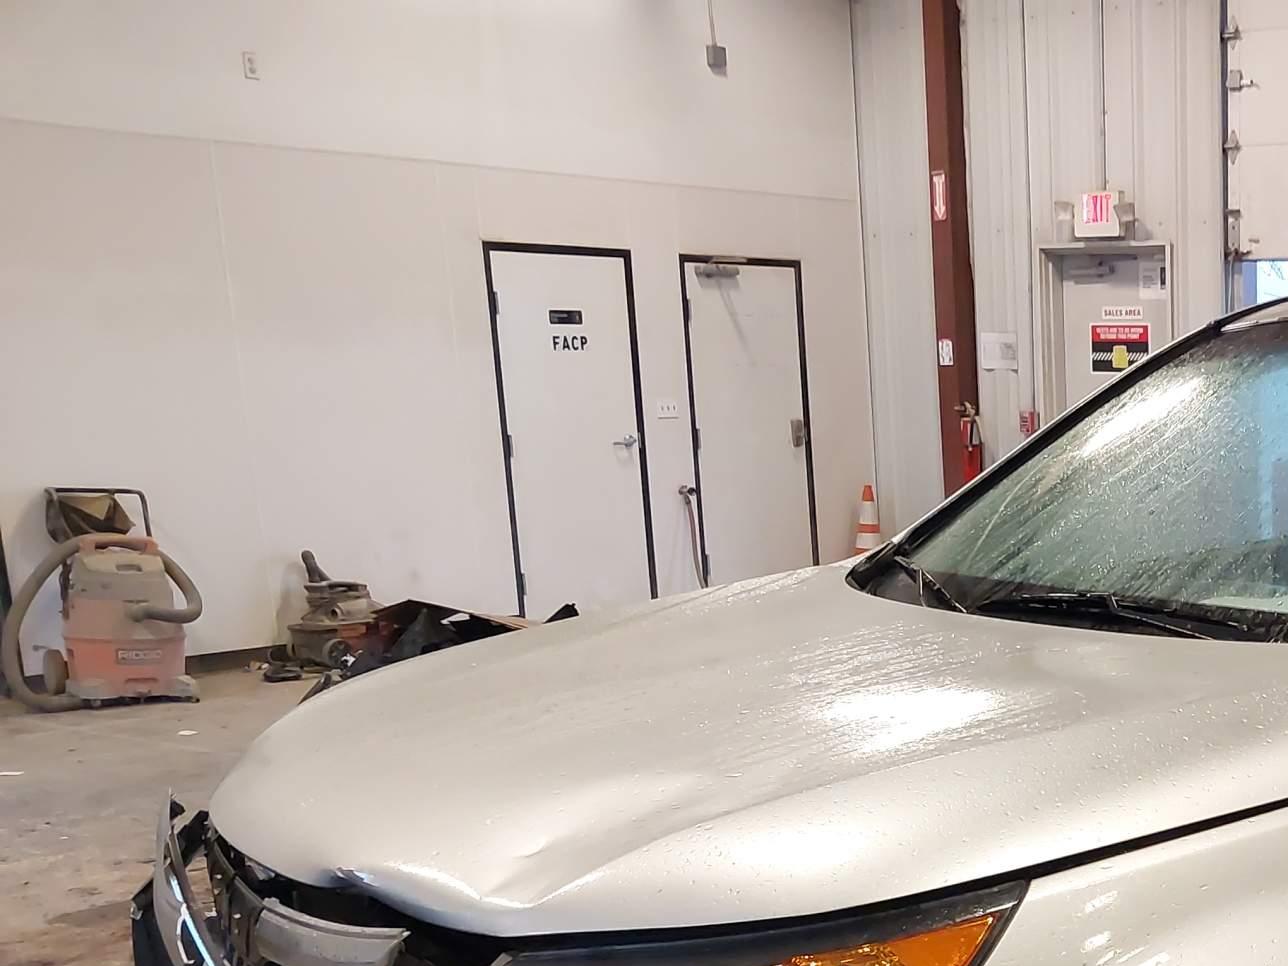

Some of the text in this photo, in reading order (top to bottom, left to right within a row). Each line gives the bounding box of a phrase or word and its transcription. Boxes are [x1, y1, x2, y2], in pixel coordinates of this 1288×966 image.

[1104, 308, 1142, 317] SALES AREA
[552, 335, 588, 351] FACP
